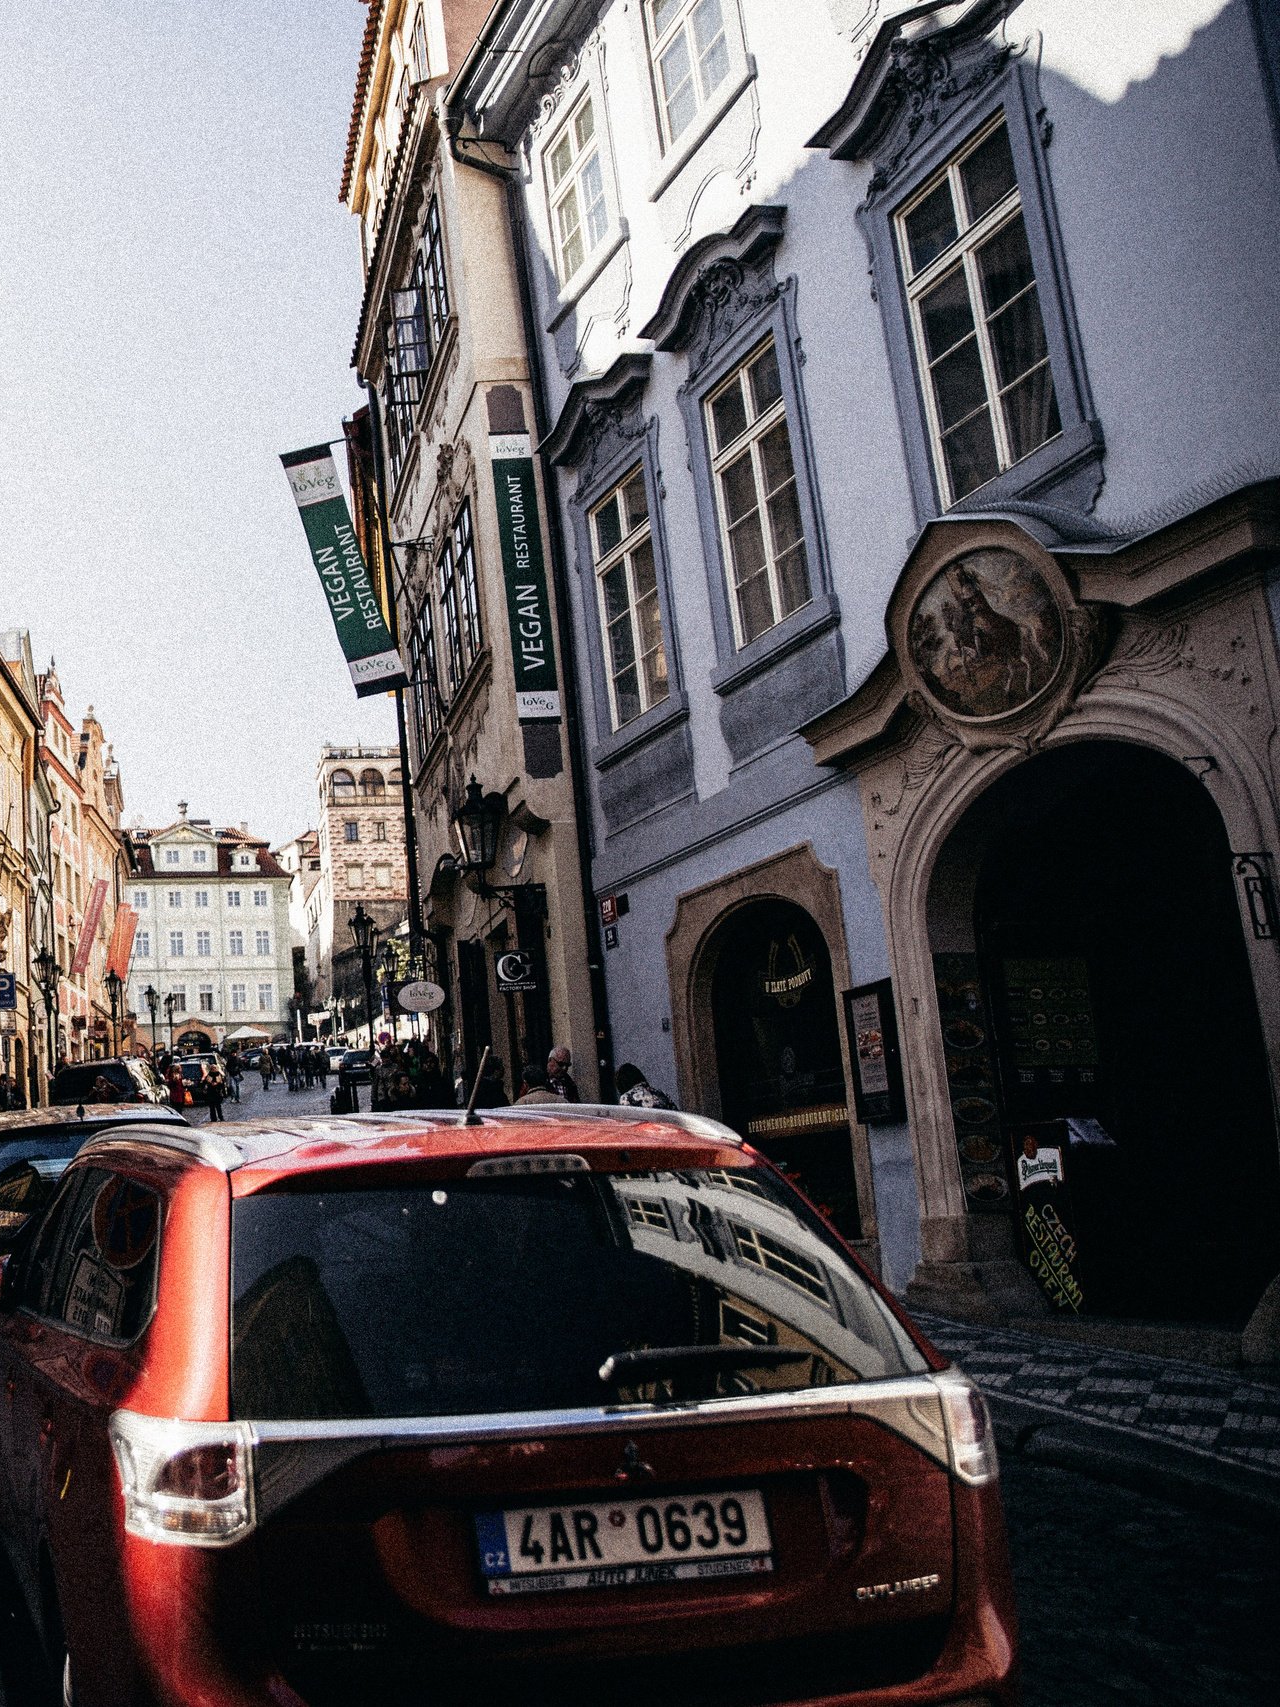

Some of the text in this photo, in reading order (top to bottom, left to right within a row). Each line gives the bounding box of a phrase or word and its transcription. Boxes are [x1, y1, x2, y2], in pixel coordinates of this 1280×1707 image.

[315, 546, 355, 621] VEGAN
[334, 524, 382, 630] RESTAURANT
[507, 475, 546, 671] VEGAN RESTAURANT
[789, 1109, 831, 1127] RESTAURANT
[1024, 1203, 1084, 1306] RESTAURANT
[1040, 1203, 1078, 1263] CZECH
[1029, 1248, 1069, 1308] OPEN
[484, 1552, 506, 1568] CZ
[521, 1498, 748, 1564] 4AR 0639
[509, 1575, 567, 1592] MITSUBISHI
[587, 1568, 626, 1587] AUTO
[856, 1573, 940, 1600] OUTLANDER
